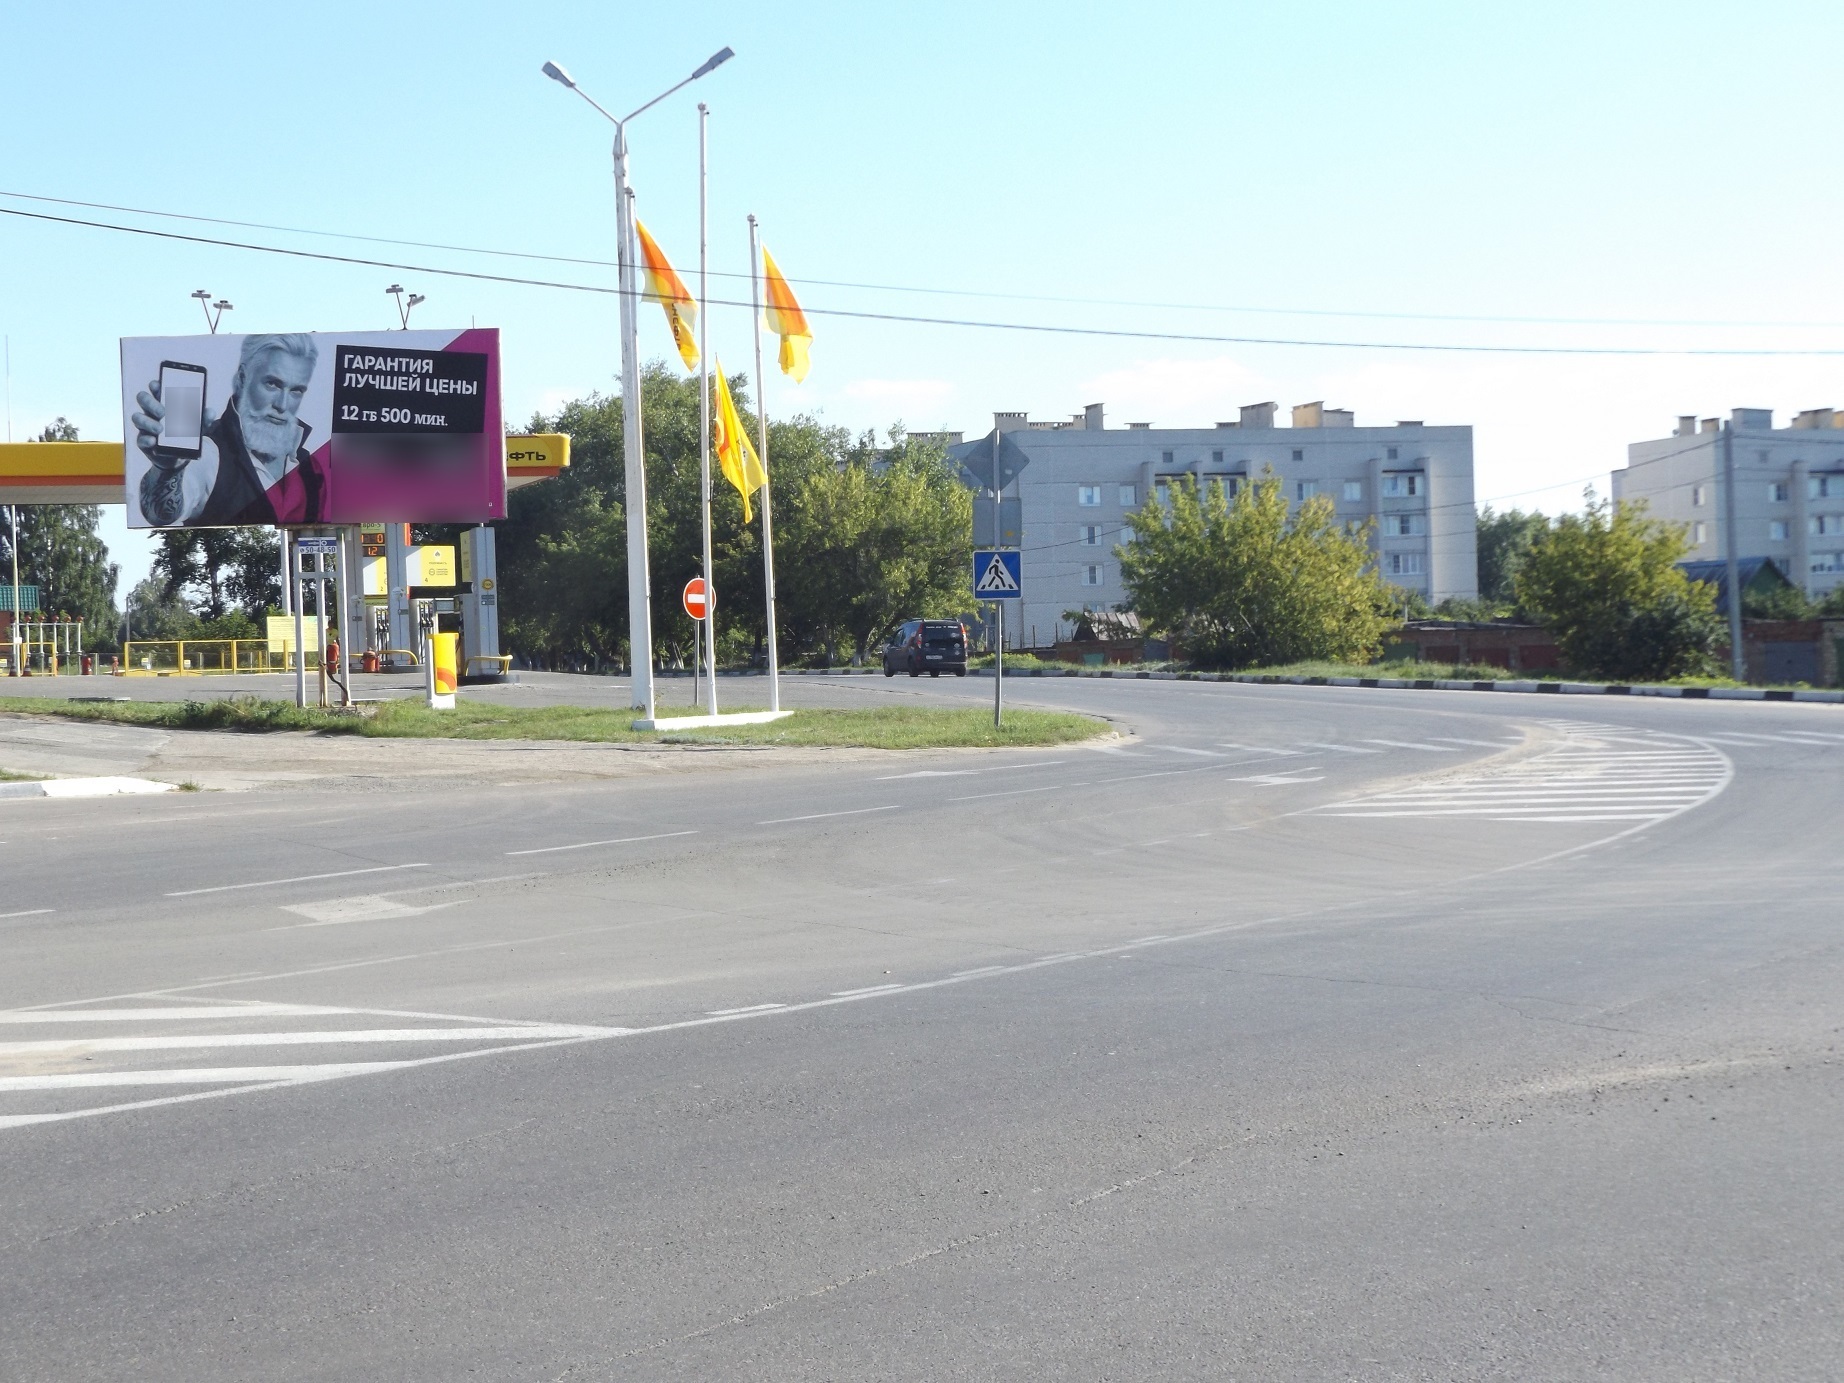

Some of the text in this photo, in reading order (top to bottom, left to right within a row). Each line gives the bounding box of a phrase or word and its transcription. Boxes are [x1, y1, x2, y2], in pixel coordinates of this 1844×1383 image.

[343, 354, 433, 374] ГАРАНТИЯ
[343, 373, 477, 395] ЛУЧШЕЙ ЦЕНЫ
[341, 405, 358, 420] 12
[381, 408, 410, 424] 500
[507, 452, 546, 461] ФТЬ
